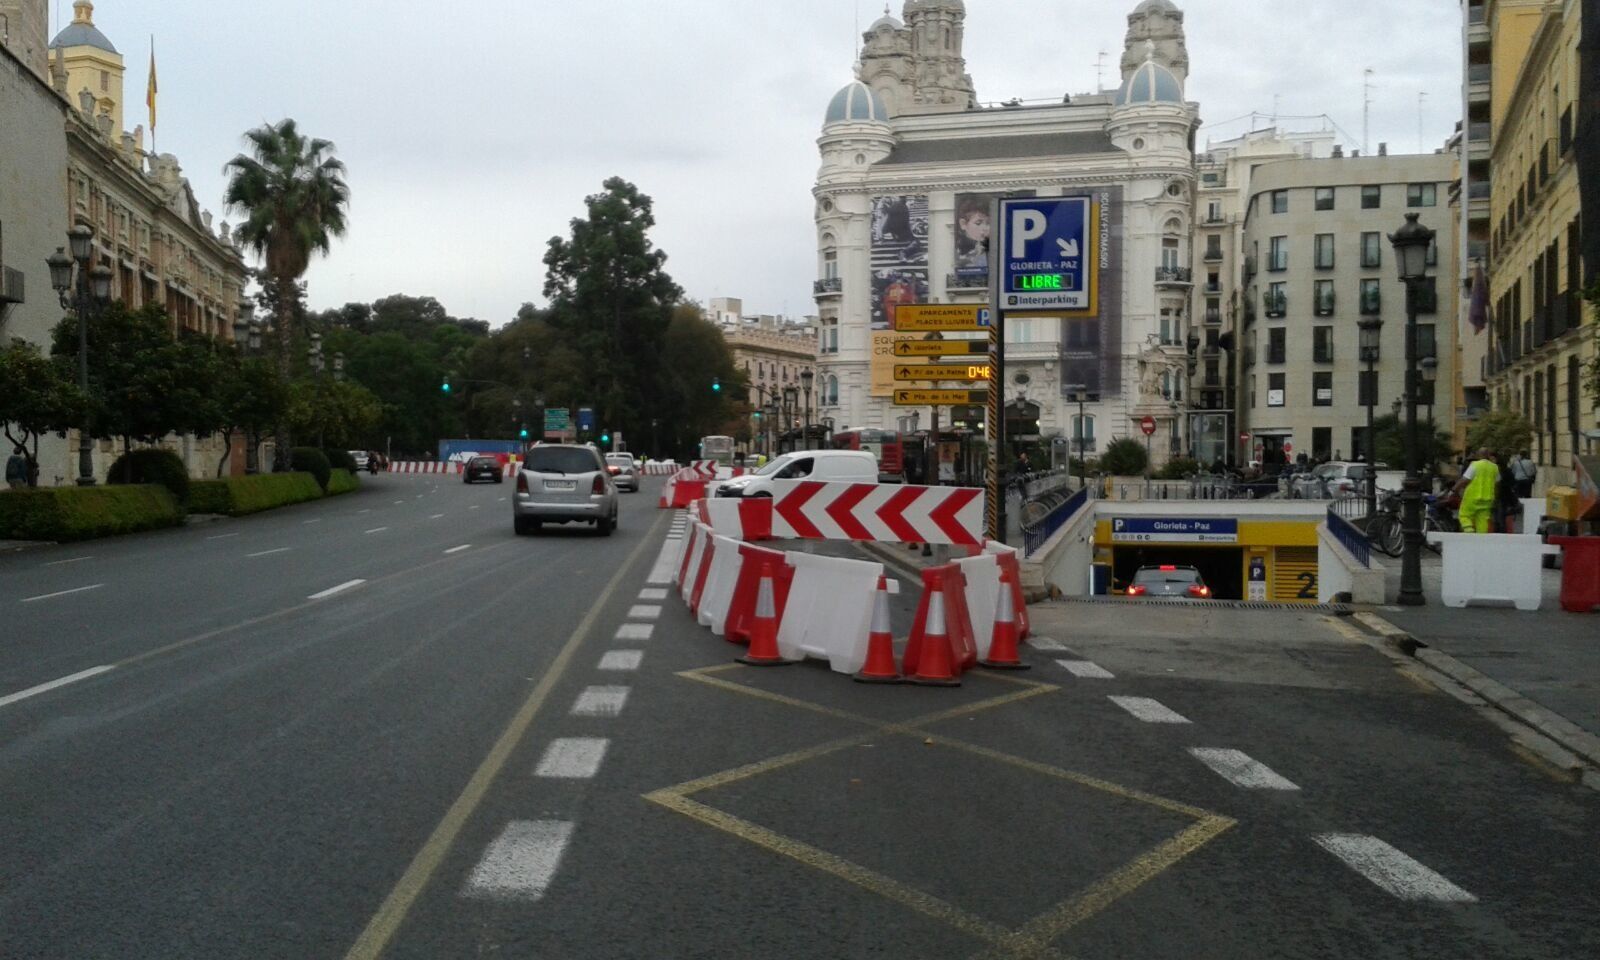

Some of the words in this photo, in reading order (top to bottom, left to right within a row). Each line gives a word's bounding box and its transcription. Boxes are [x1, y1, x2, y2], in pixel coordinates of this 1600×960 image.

[1011, 209, 1047, 258] P
[1010, 261, 1053, 270] GLORIETA
[1060, 261, 1078, 269] PAZ
[1022, 275, 1062, 289] LIBRE
[1019, 295, 1078, 305] Interparking
[981, 308, 990, 325] P
[1115, 519, 1124, 531] P
[1153, 521, 1188, 530] Glorieta
[1194, 520, 1211, 530] Paz
[1252, 567, 1261, 577] P
[1296, 571, 1316, 598] 2
